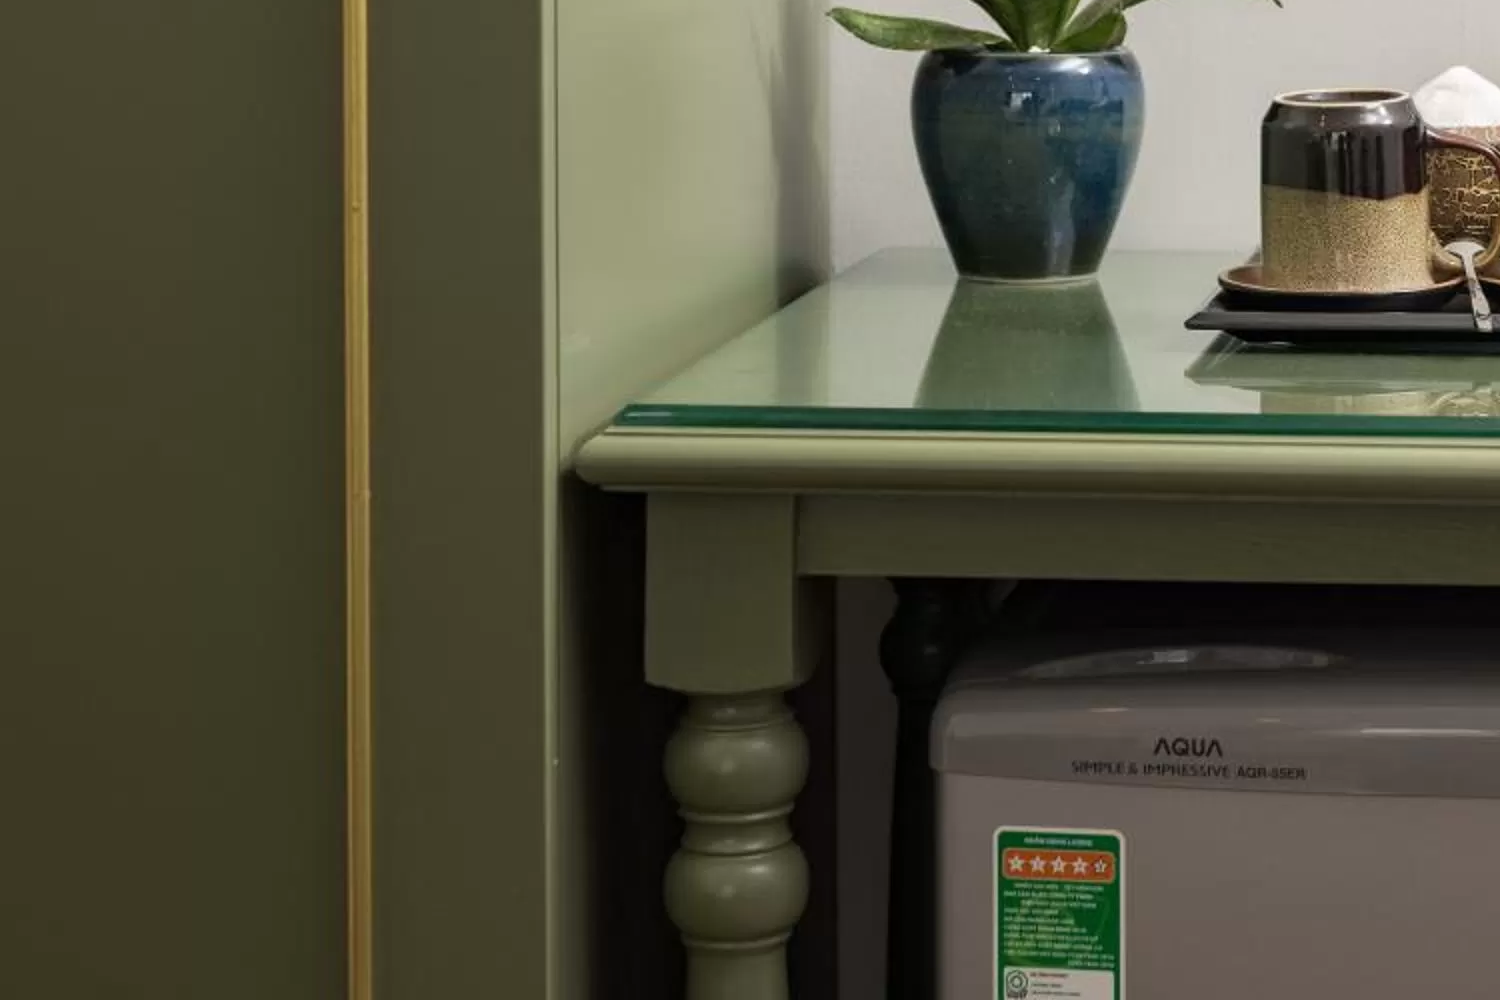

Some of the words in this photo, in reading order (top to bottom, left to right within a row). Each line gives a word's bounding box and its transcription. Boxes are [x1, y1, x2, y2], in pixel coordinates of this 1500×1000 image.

[1153, 737, 1223, 757] AQUA
[1072, 759, 1122, 775] SIMPLE
[1143, 763, 1229, 778] IMPRESSIVE
